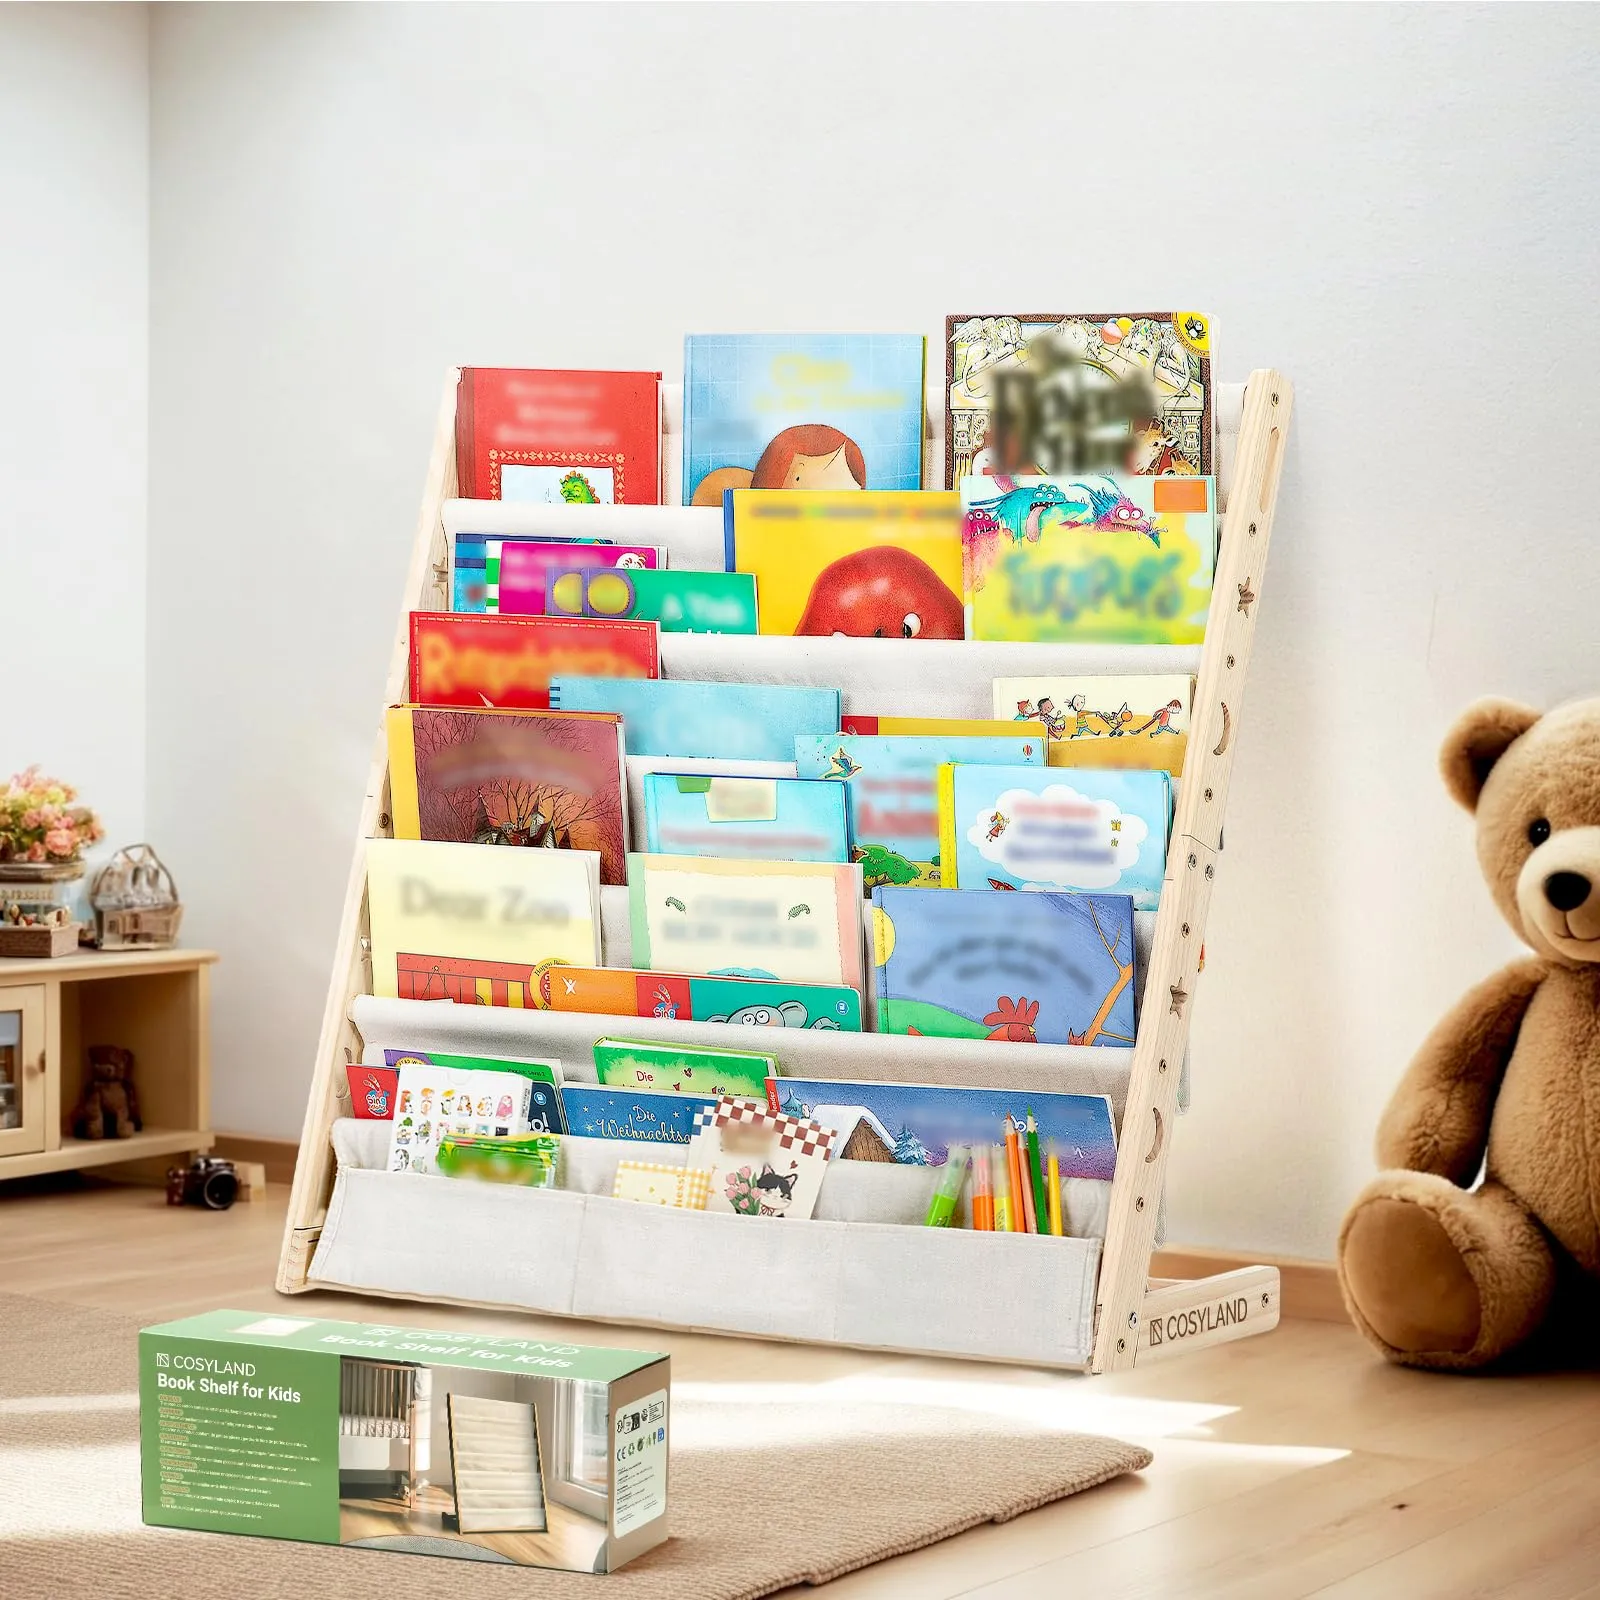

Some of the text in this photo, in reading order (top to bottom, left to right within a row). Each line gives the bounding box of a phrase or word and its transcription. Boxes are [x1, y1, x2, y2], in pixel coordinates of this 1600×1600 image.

[636, 1070, 653, 1082] Die
[633, 1104, 656, 1122] Die
[1167, 1297, 1248, 1341] COSYLAND
[320, 1335, 574, 1369] Book Shelf for Kids
[405, 1331, 579, 1356] COSYLAND
[173, 1355, 256, 1377] COSYLAND
[157, 1372, 301, 1404] Book Shelf for Kids
